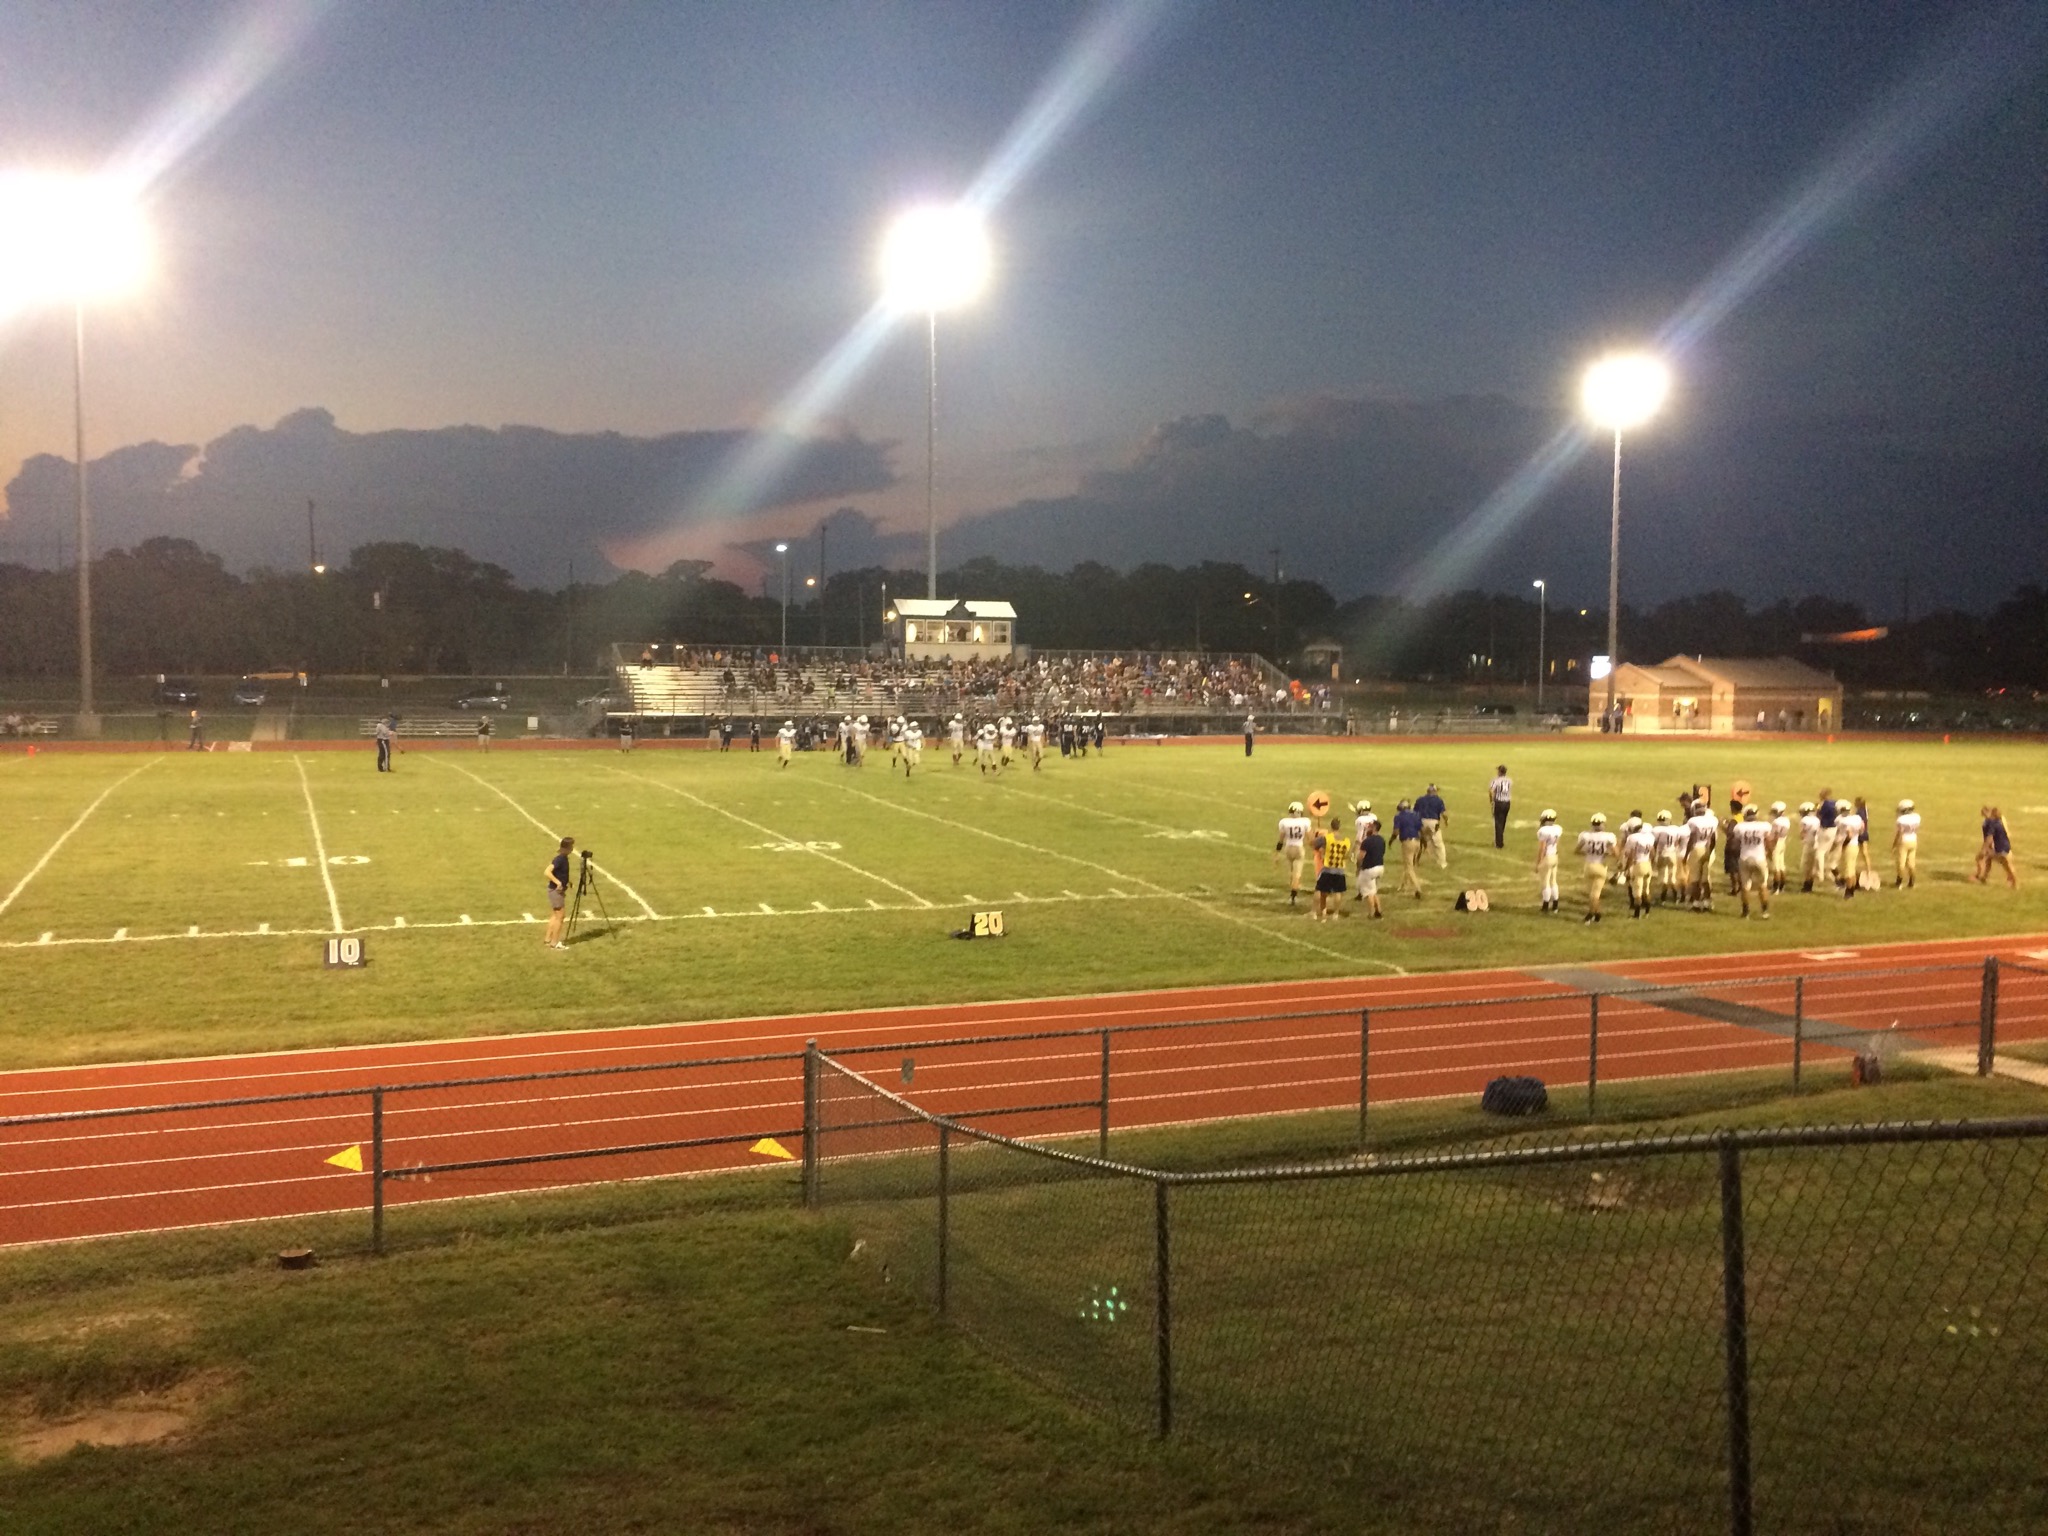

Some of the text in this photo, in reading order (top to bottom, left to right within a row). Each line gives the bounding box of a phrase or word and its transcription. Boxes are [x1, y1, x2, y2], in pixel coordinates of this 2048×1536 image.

[1465, 889, 1489, 912] 30
[973, 912, 1004, 936] 20
[328, 938, 360, 964] 10
